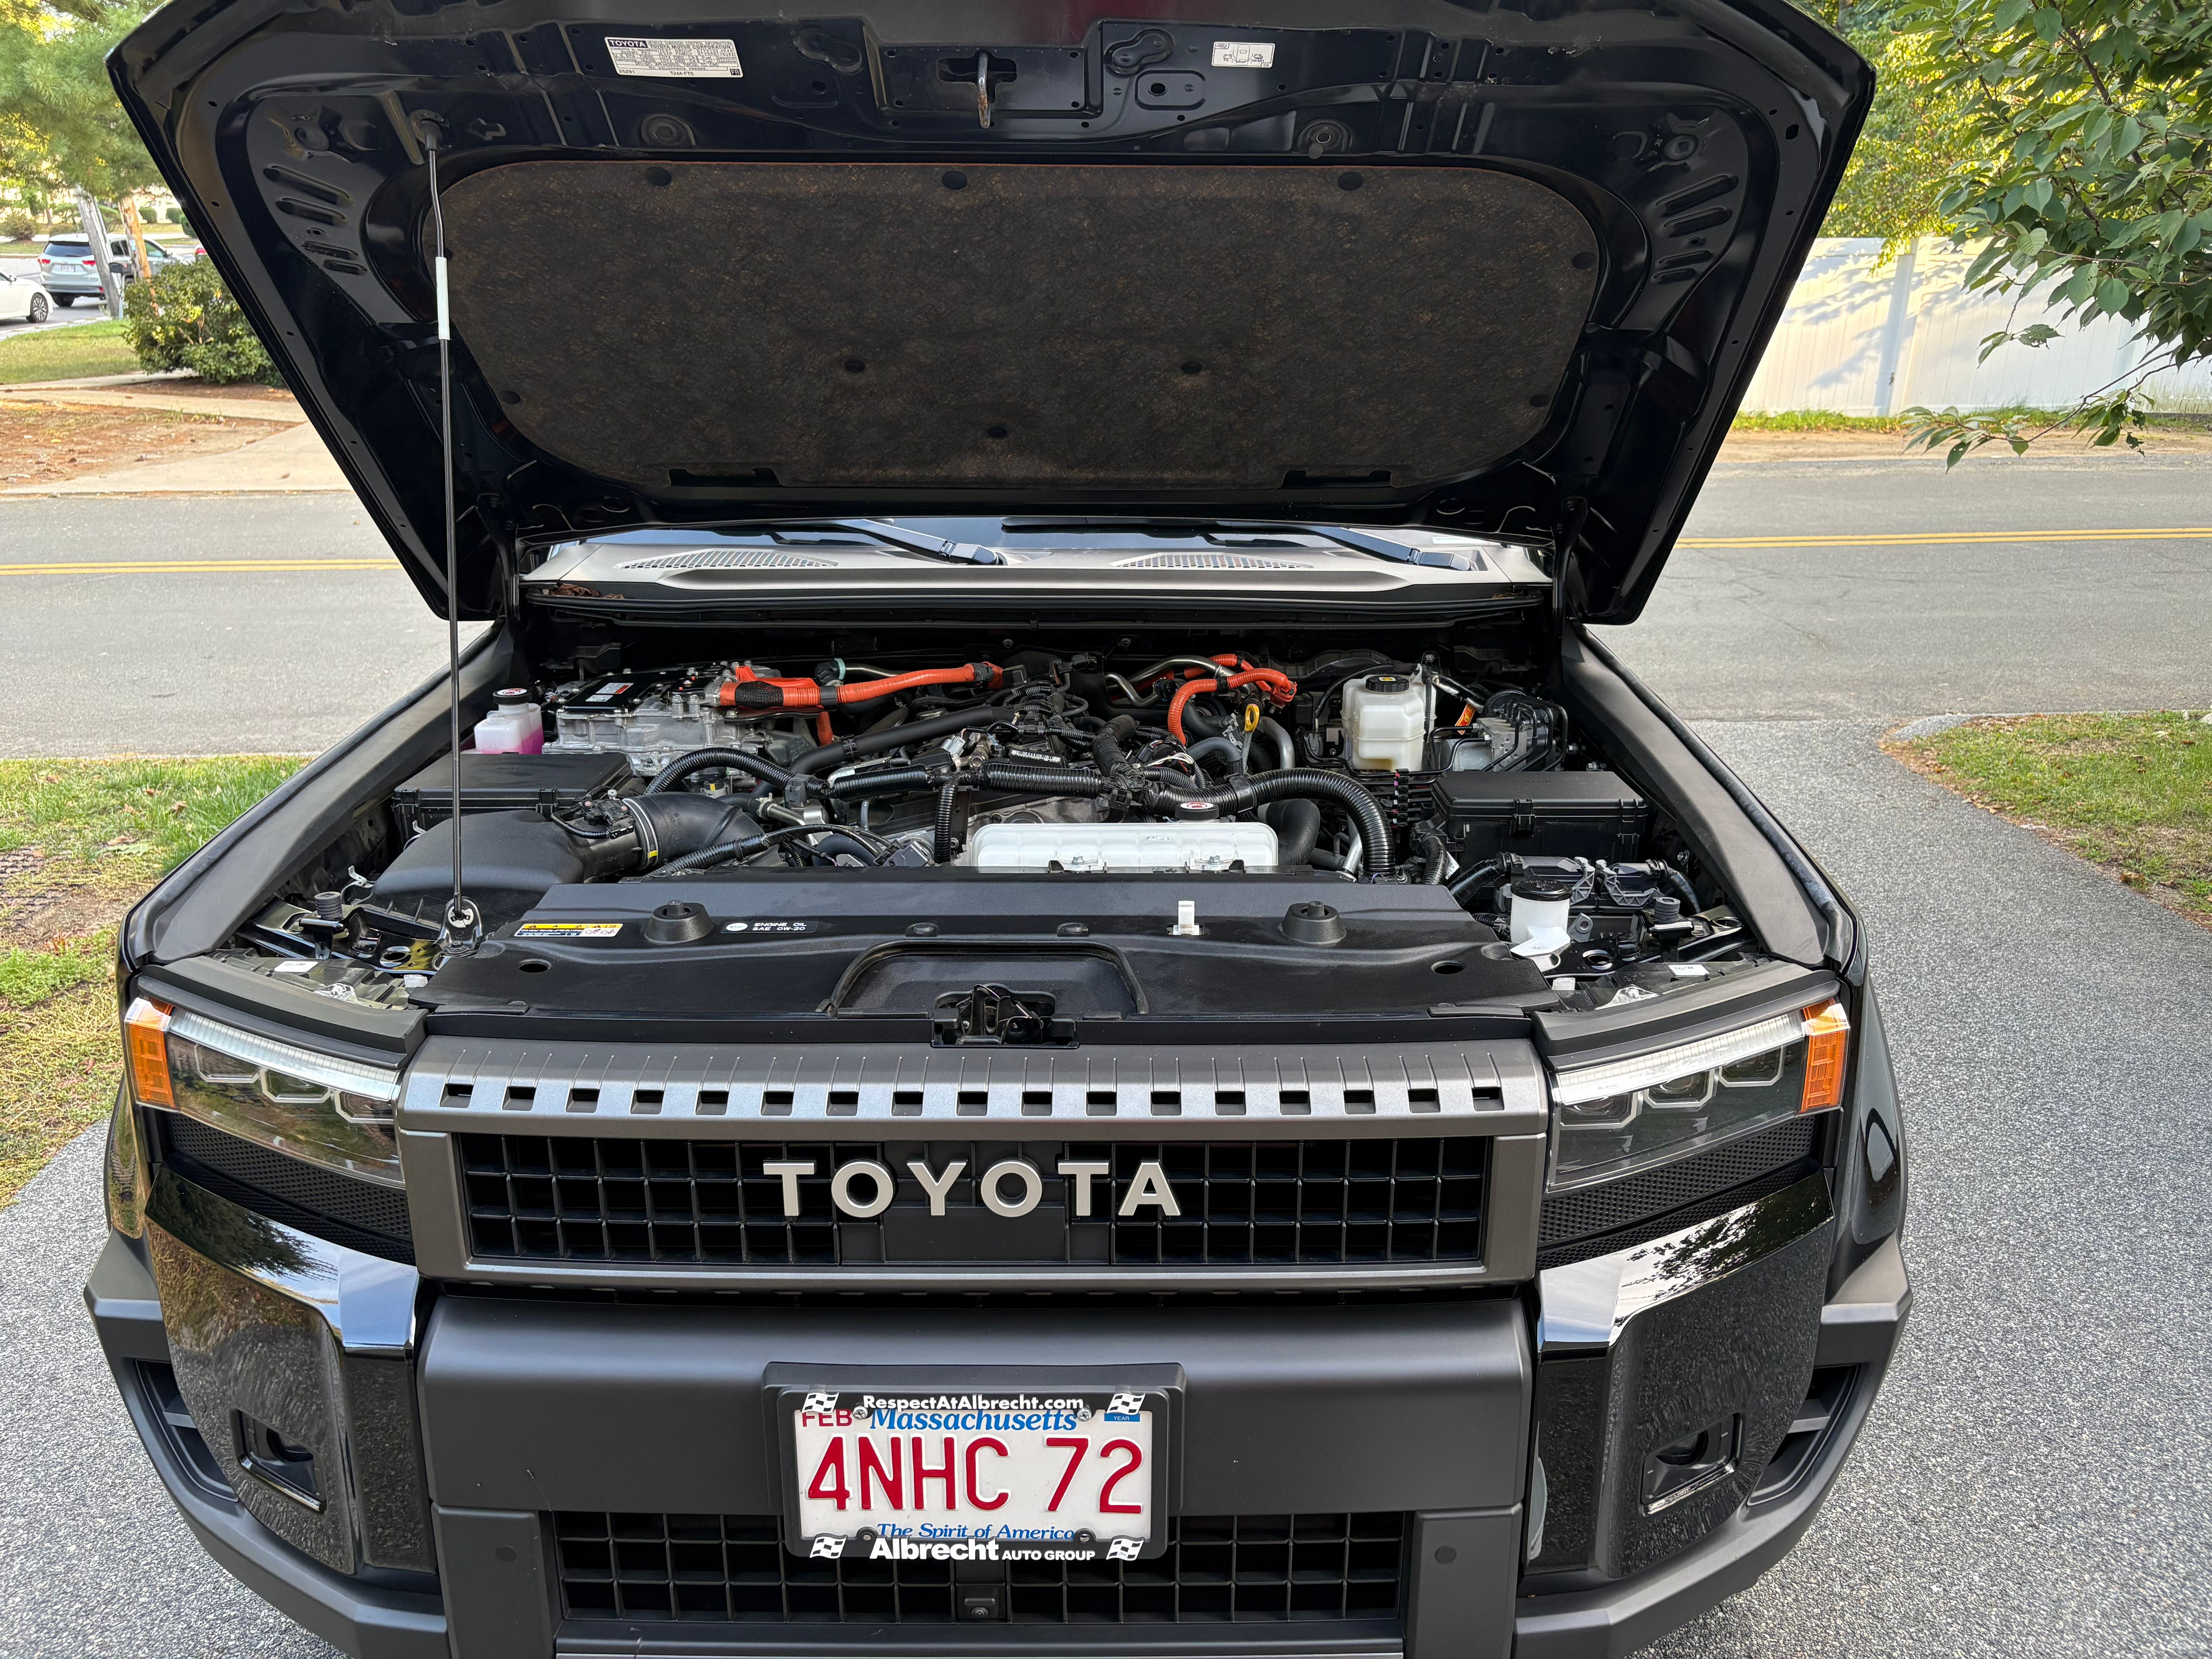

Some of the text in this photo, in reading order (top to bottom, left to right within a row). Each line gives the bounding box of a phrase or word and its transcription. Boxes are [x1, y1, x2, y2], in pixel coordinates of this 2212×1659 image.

[763, 1159, 1180, 1218] TOYOTA
[863, 1395, 1084, 1412] RespectAtAlbrecht.com
[802, 1409, 852, 1427] FEB
[870, 1408, 1077, 1431] Massachusetts
[807, 1437, 1142, 1513] 4NHC 72
[877, 1523, 913, 1537] The
[919, 1523, 969, 1538] Spirit
[974, 1524, 993, 1539] of
[869, 1537, 1096, 1560] Albrecht AUTO GROUP
